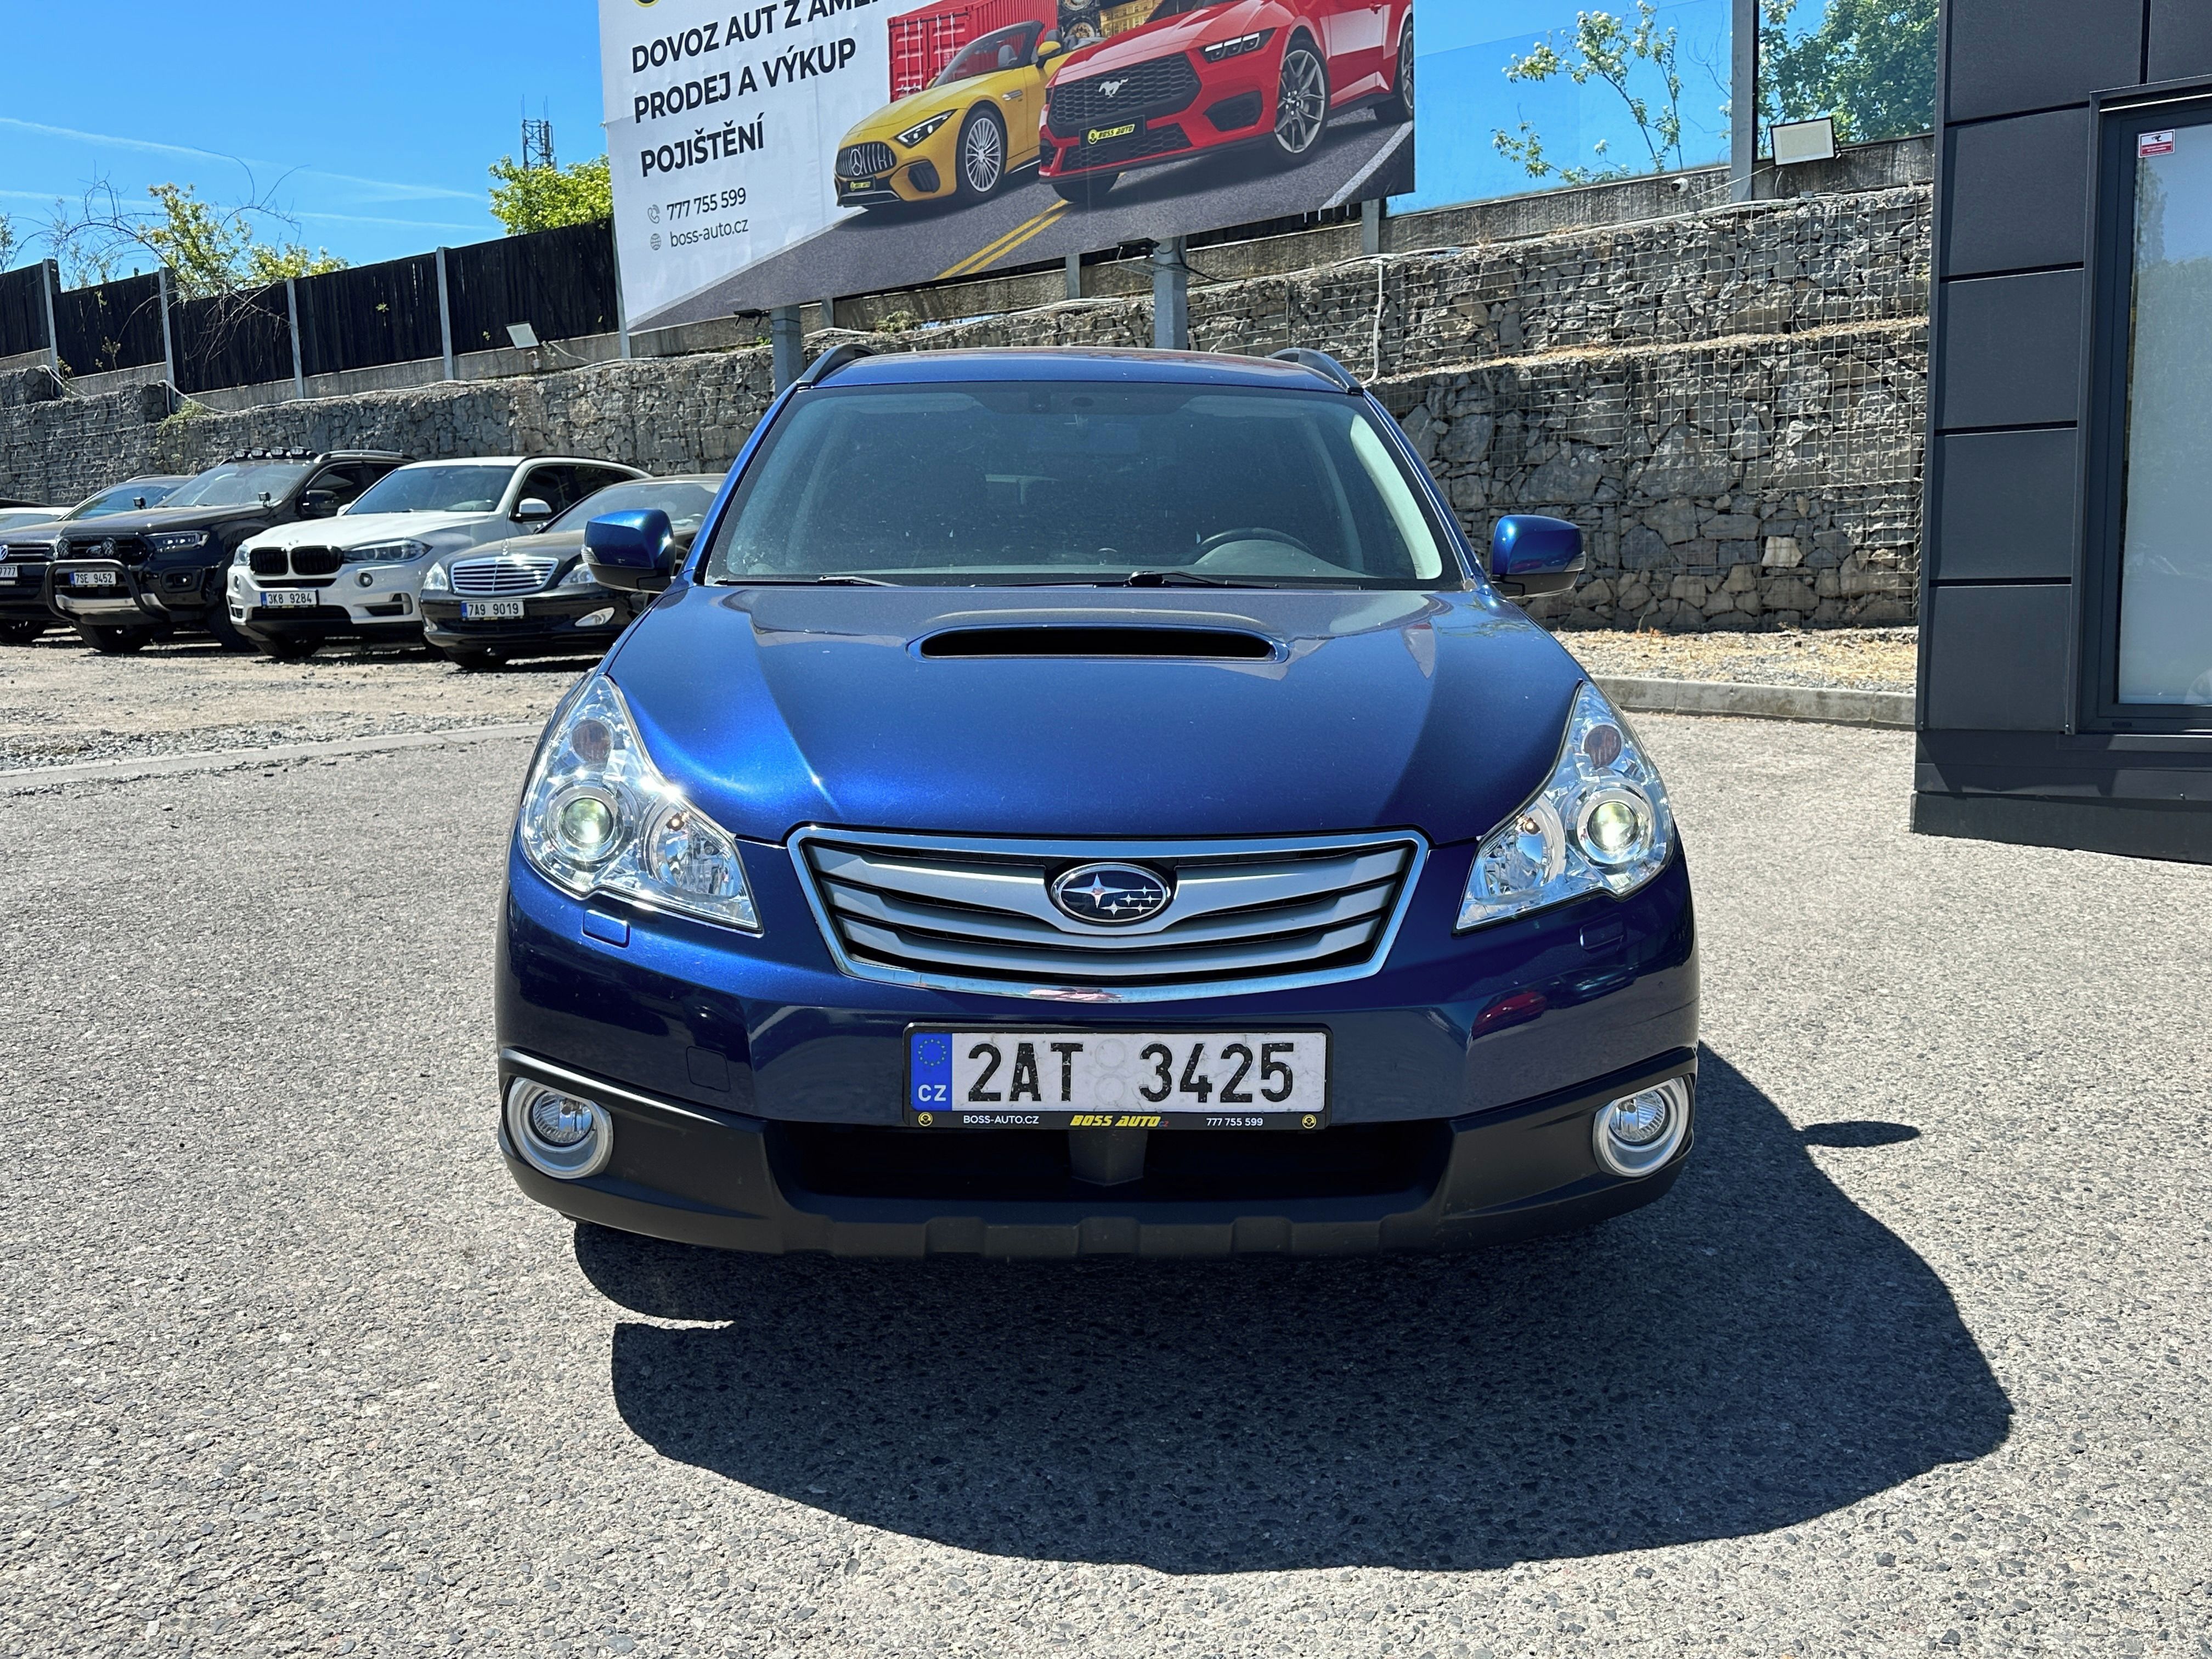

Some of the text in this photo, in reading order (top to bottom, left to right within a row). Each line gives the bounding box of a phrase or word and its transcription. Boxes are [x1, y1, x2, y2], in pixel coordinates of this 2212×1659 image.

[632, 21, 719, 74] DOVOZ
[725, 3, 777, 47] AUT
[784, 0, 802, 29] Z
[634, 38, 856, 124] PRODEJ A VÝKUP
[640, 111, 764, 178] POJIŠTĚNÍ
[667, 187, 746, 221] 777 755 599
[670, 219, 749, 247] boss-auto.cz
[75, 573, 89, 584] 7SE
[93, 573, 112, 583] 9452
[268, 594, 284, 604] 3K8
[289, 593, 312, 603] 9284
[469, 604, 486, 616] 7A9
[493, 603, 519, 615] 9019
[968, 1042, 1294, 1103] 2AT 3425
[918, 1084, 947, 1102] CZ
[963, 1115, 1040, 1124] BOSS-AUTO.CZ
[1070, 1115, 1113, 1126] BOSS
[1206, 1118, 1263, 1126] 777 755 599
